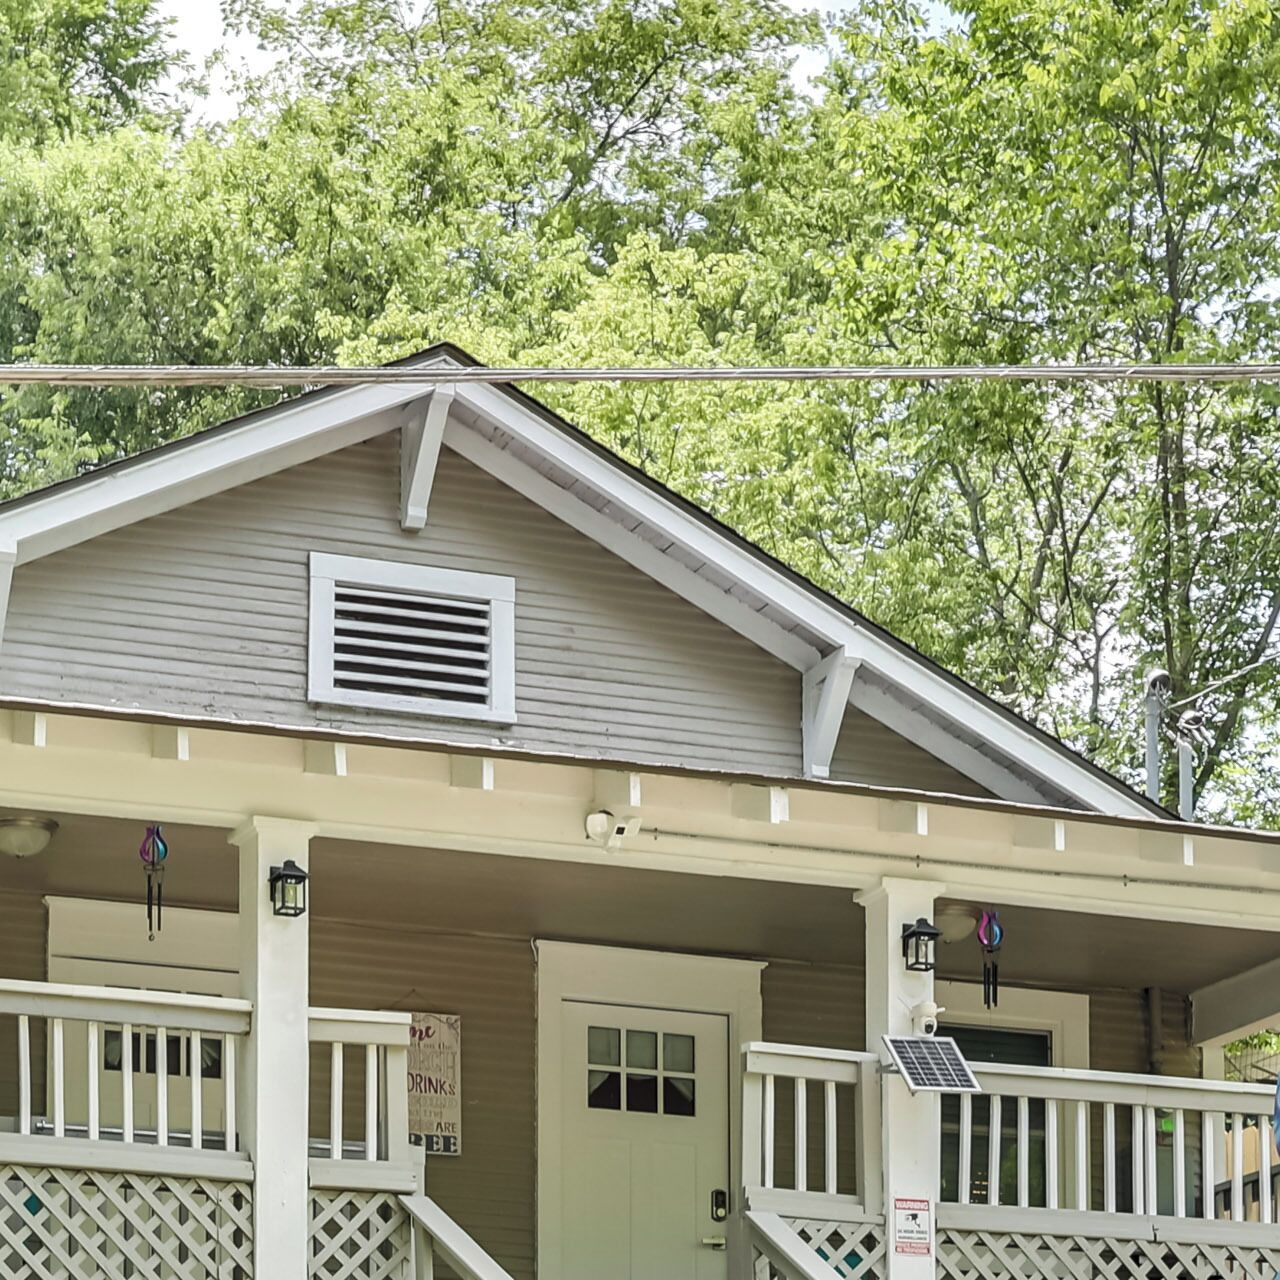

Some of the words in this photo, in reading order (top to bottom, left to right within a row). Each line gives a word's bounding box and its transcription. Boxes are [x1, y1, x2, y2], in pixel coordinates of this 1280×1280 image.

[435, 1121, 457, 1134] ARE
[409, 1133, 458, 1153] REE
[896, 1200, 928, 1209] WARNING
